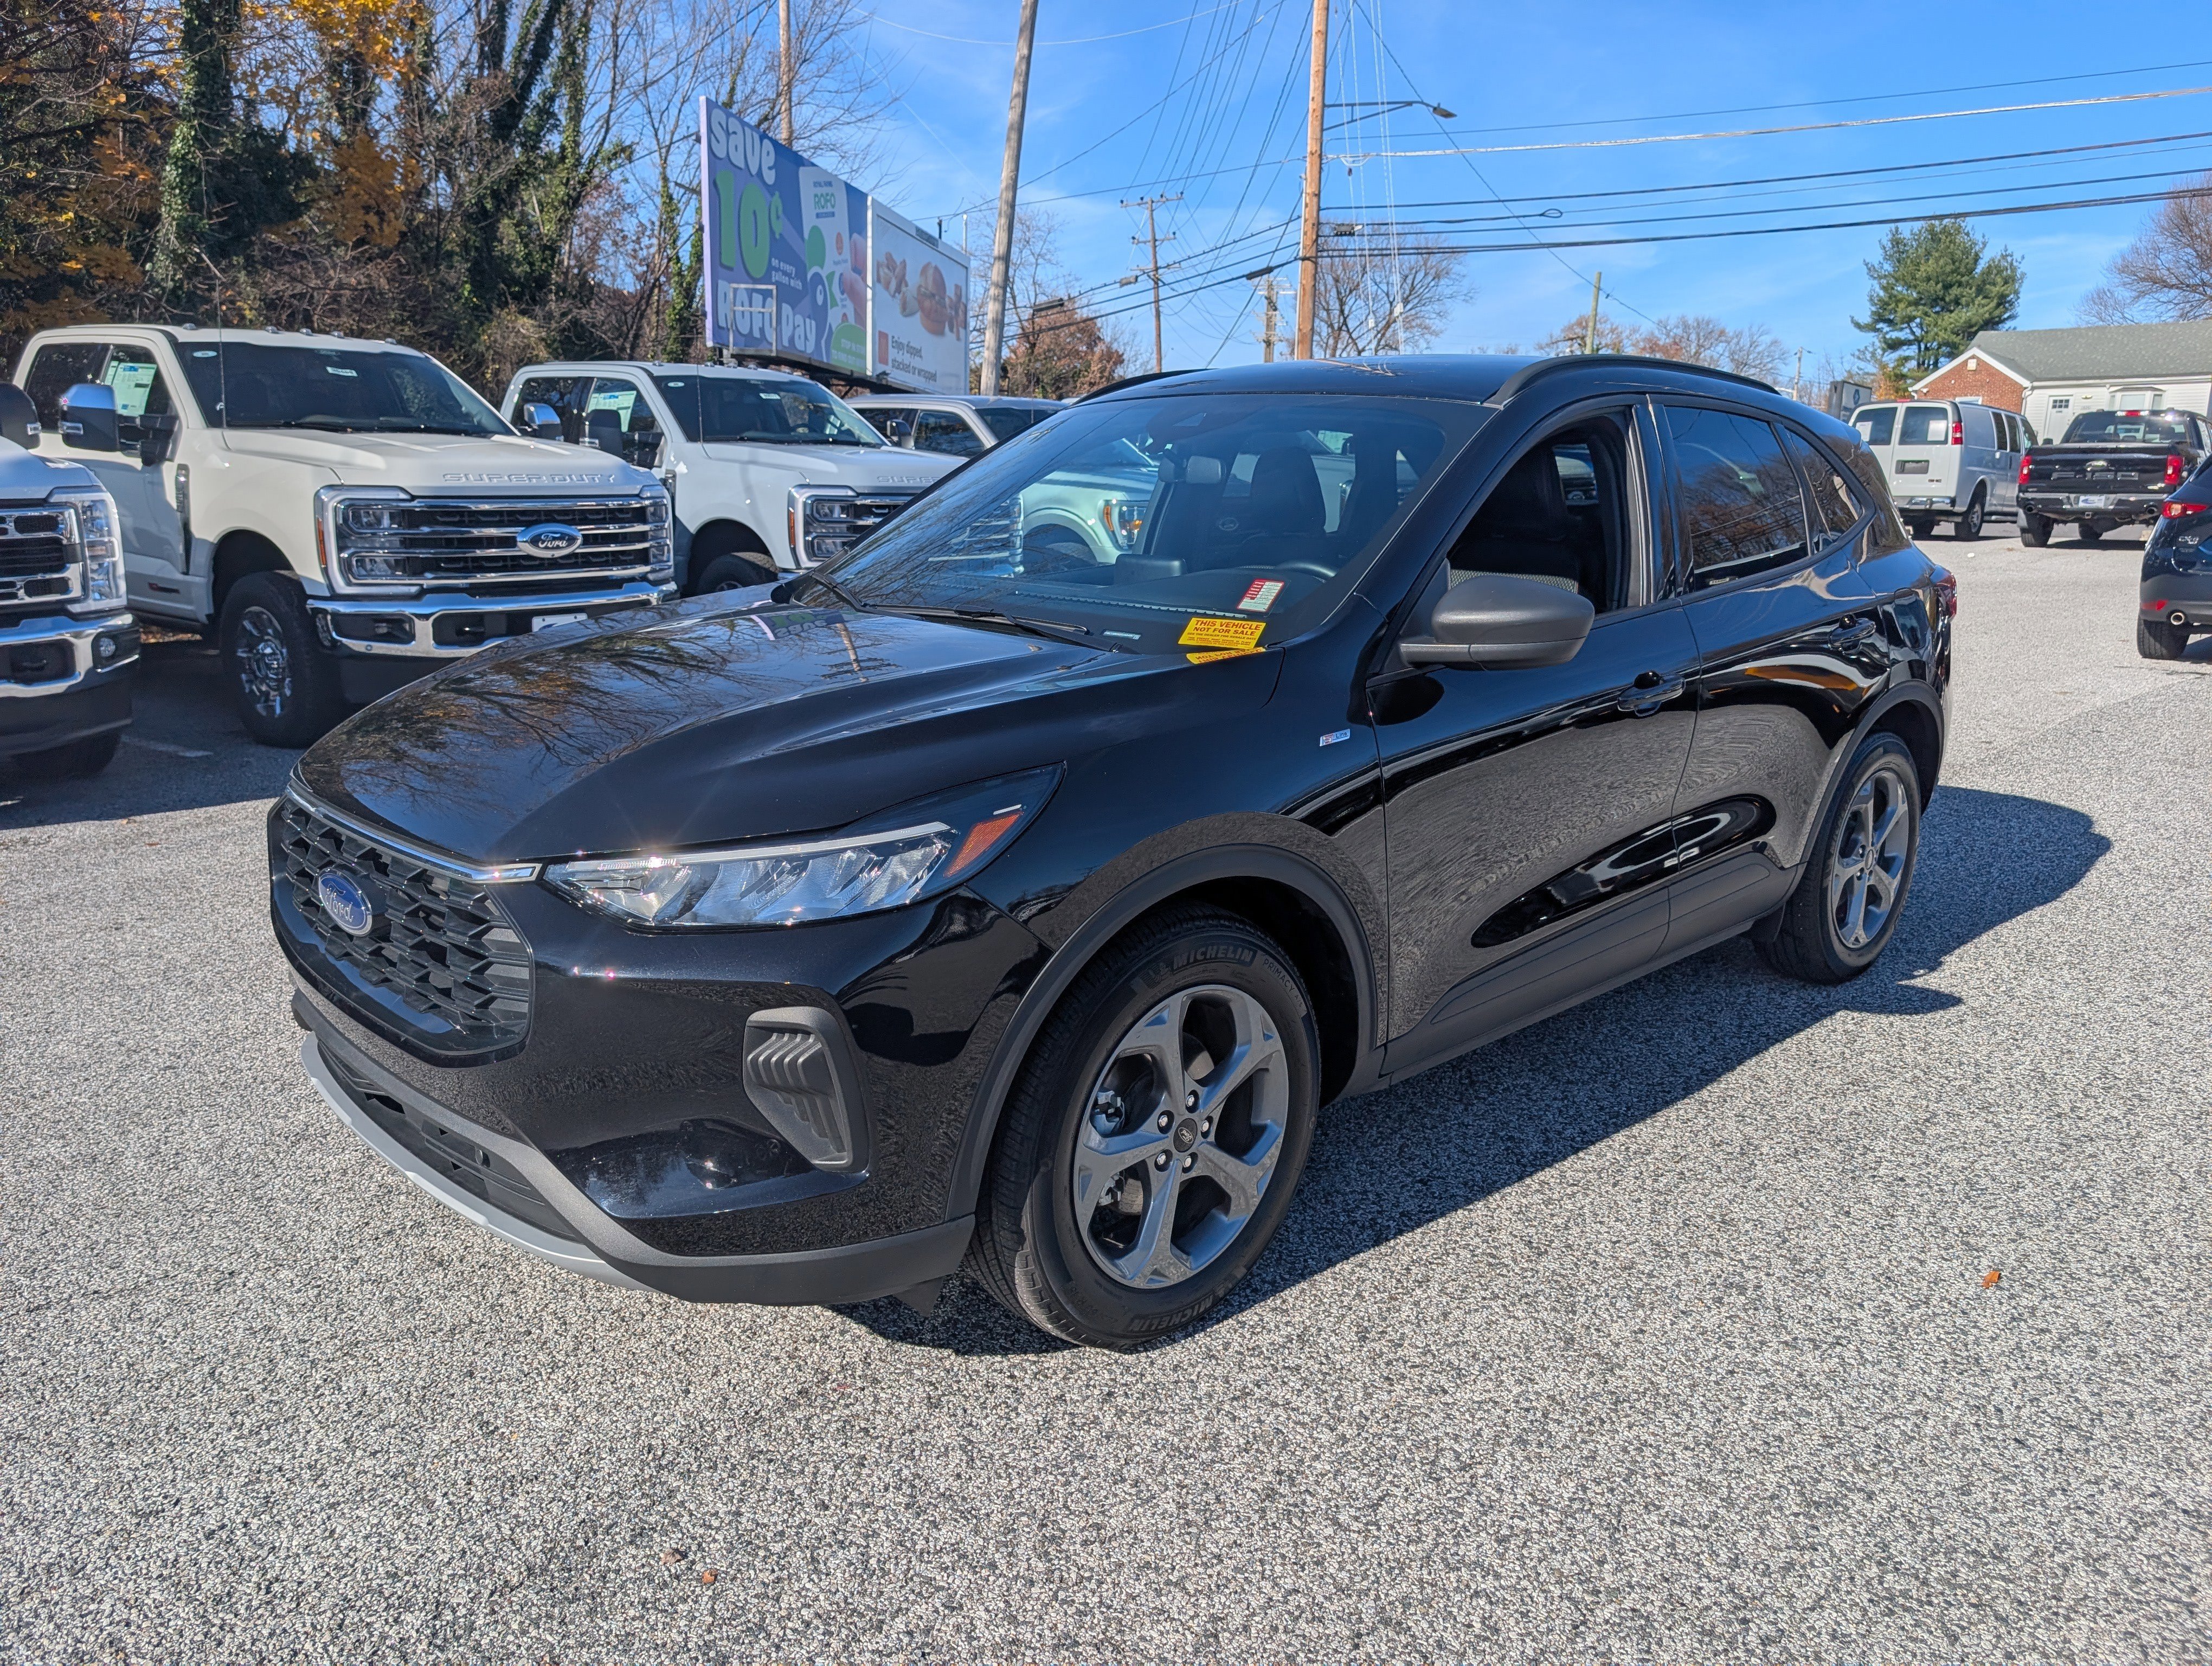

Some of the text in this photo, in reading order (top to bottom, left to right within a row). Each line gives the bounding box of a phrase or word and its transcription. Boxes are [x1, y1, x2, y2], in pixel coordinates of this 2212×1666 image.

[782, 303, 816, 354] Pay
[891, 335, 905, 356] Enjoy
[891, 357, 911, 374] stacked
[912, 366, 917, 375] or
[443, 473, 615, 483] SUPER DUTY
[538, 533, 569, 548] Ford
[1220, 621, 1262, 631] VEHICLE
[325, 882, 353, 922] Ford
[1173, 946, 1253, 968] MICHELIN
[1262, 958, 1295, 992] PRIMACY
[1181, 1129, 1192, 1142] Ford
[1129, 1294, 1213, 1331] MICHELIN
